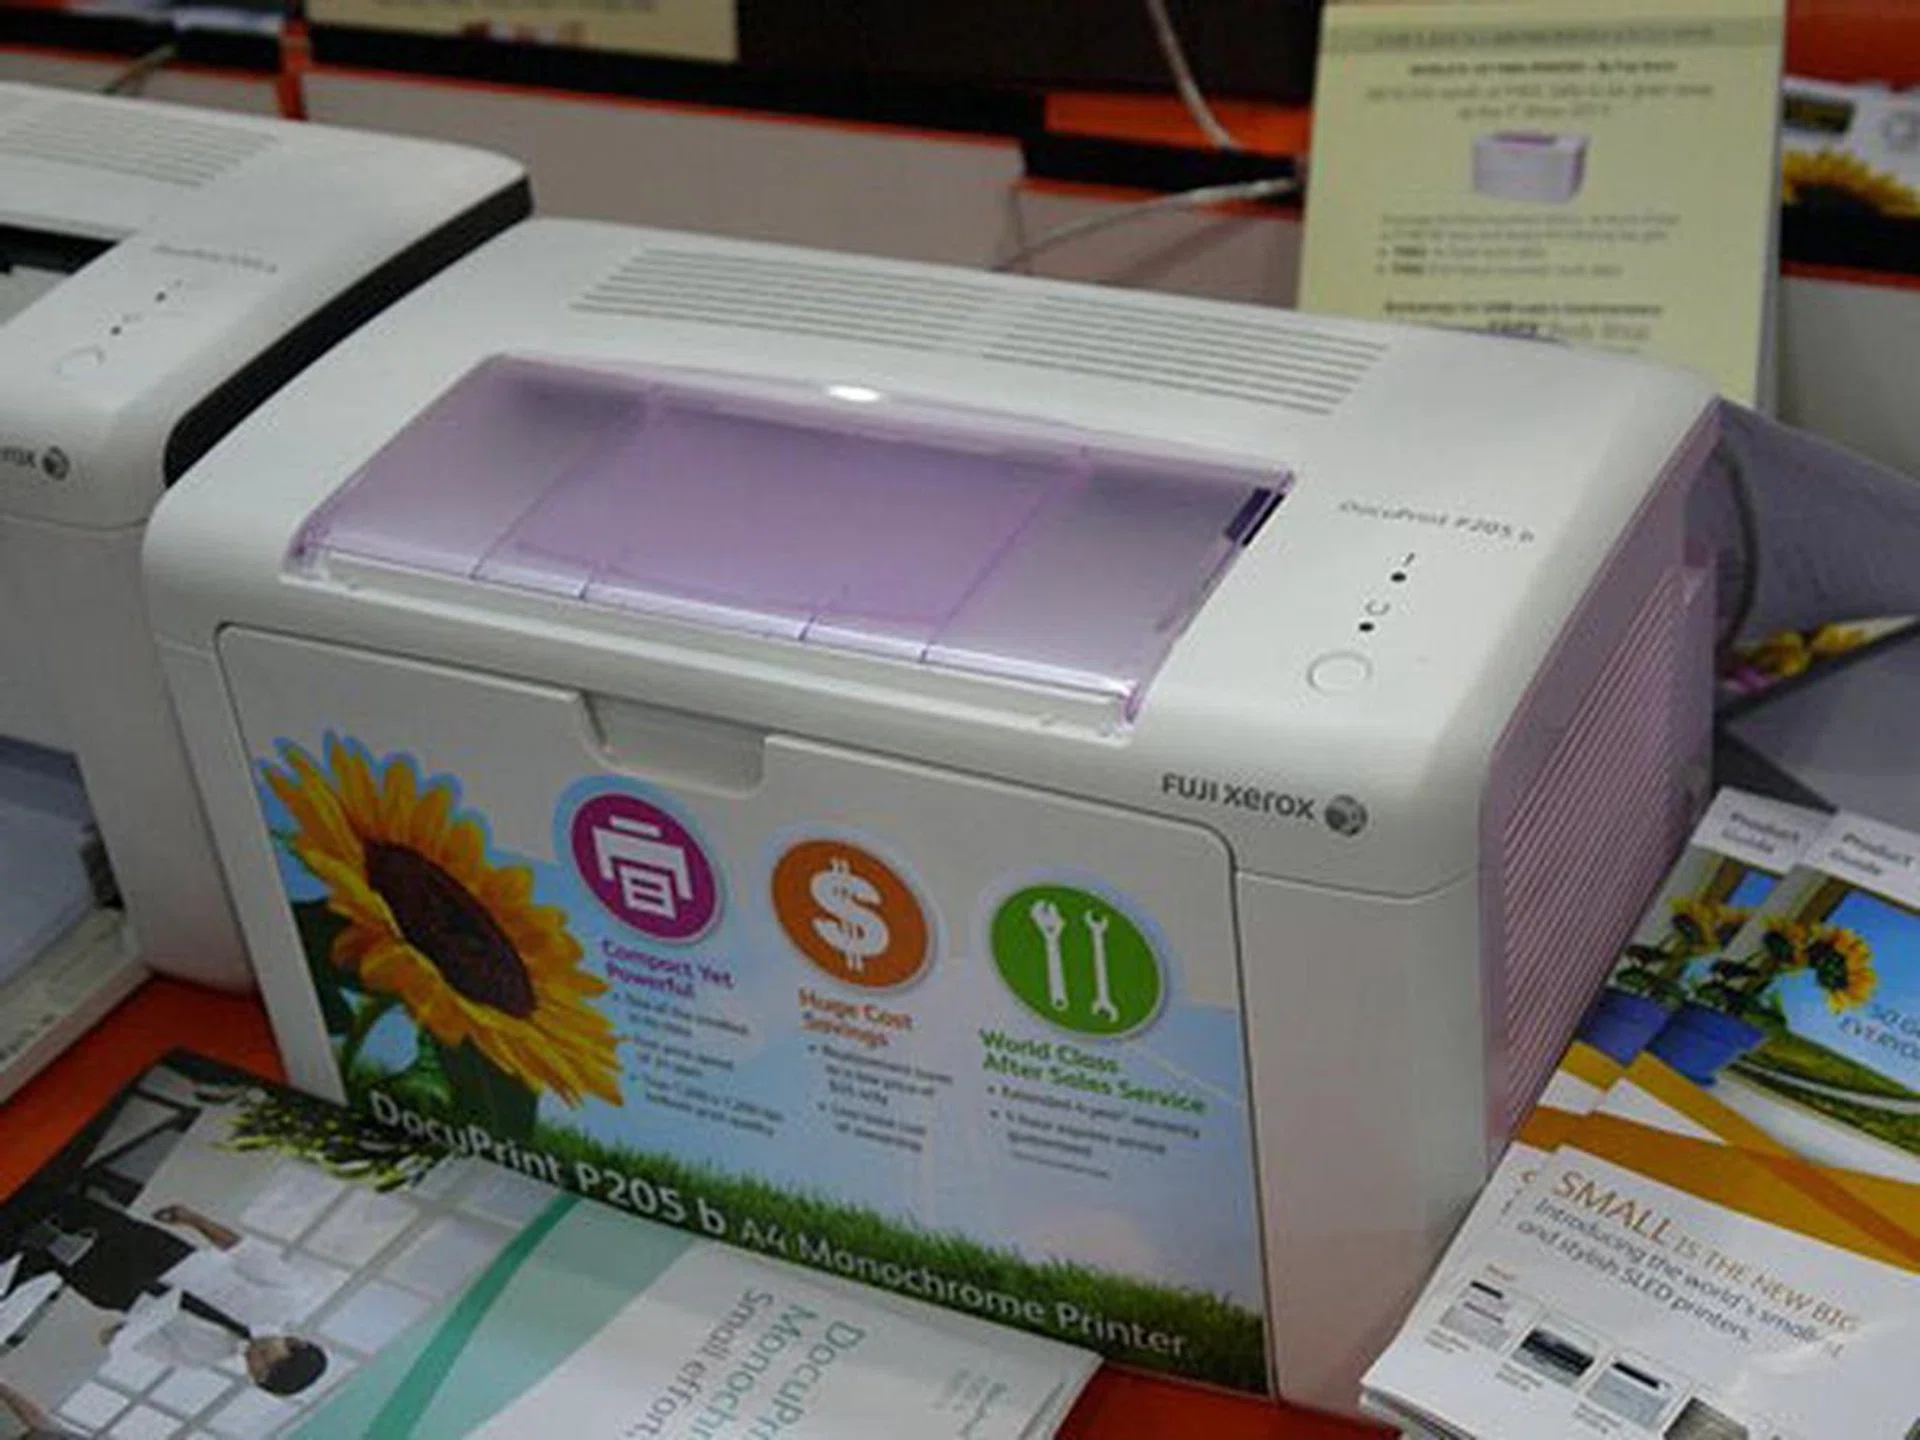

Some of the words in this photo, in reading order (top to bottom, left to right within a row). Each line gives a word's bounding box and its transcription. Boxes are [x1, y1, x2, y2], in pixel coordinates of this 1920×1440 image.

[1161, 772, 1218, 801] FUJI
[1223, 783, 1316, 820] xerox
[601, 938, 694, 978] Compact
[698, 963, 736, 990] Yet
[606, 959, 695, 998] Powerful
[799, 986, 858, 1019] Huge
[859, 1004, 914, 1030] Cost
[801, 1011, 890, 1048] Savings
[978, 1028, 1051, 1059] World
[1056, 1044, 1119, 1074] Class
[983, 1051, 1044, 1080] After
[1048, 1066, 1112, 1095] Sales
[1118, 1079, 1205, 1114] Service
[368, 1090, 562, 1182] DocuPrint
[575, 1162, 687, 1224] P205
[697, 1197, 726, 1235] b
[741, 1217, 788, 1253] A4
[799, 1235, 1047, 1323] Monochrome
[1057, 1304, 1190, 1358] Printer
[1533, 1197, 1648, 1265] Introducing
[1646, 1253, 1684, 1282] the
[1554, 1170, 1673, 1246] SMALL
[1674, 1236, 1699, 1260] IS
[1703, 1250, 1749, 1284] THE
[1751, 1273, 1816, 1313] NEW
[1516, 1219, 1560, 1246] and
[1559, 1236, 1621, 1277] stylish
[1620, 1266, 1674, 1302] SLED
[697, 1287, 775, 1361] Small
